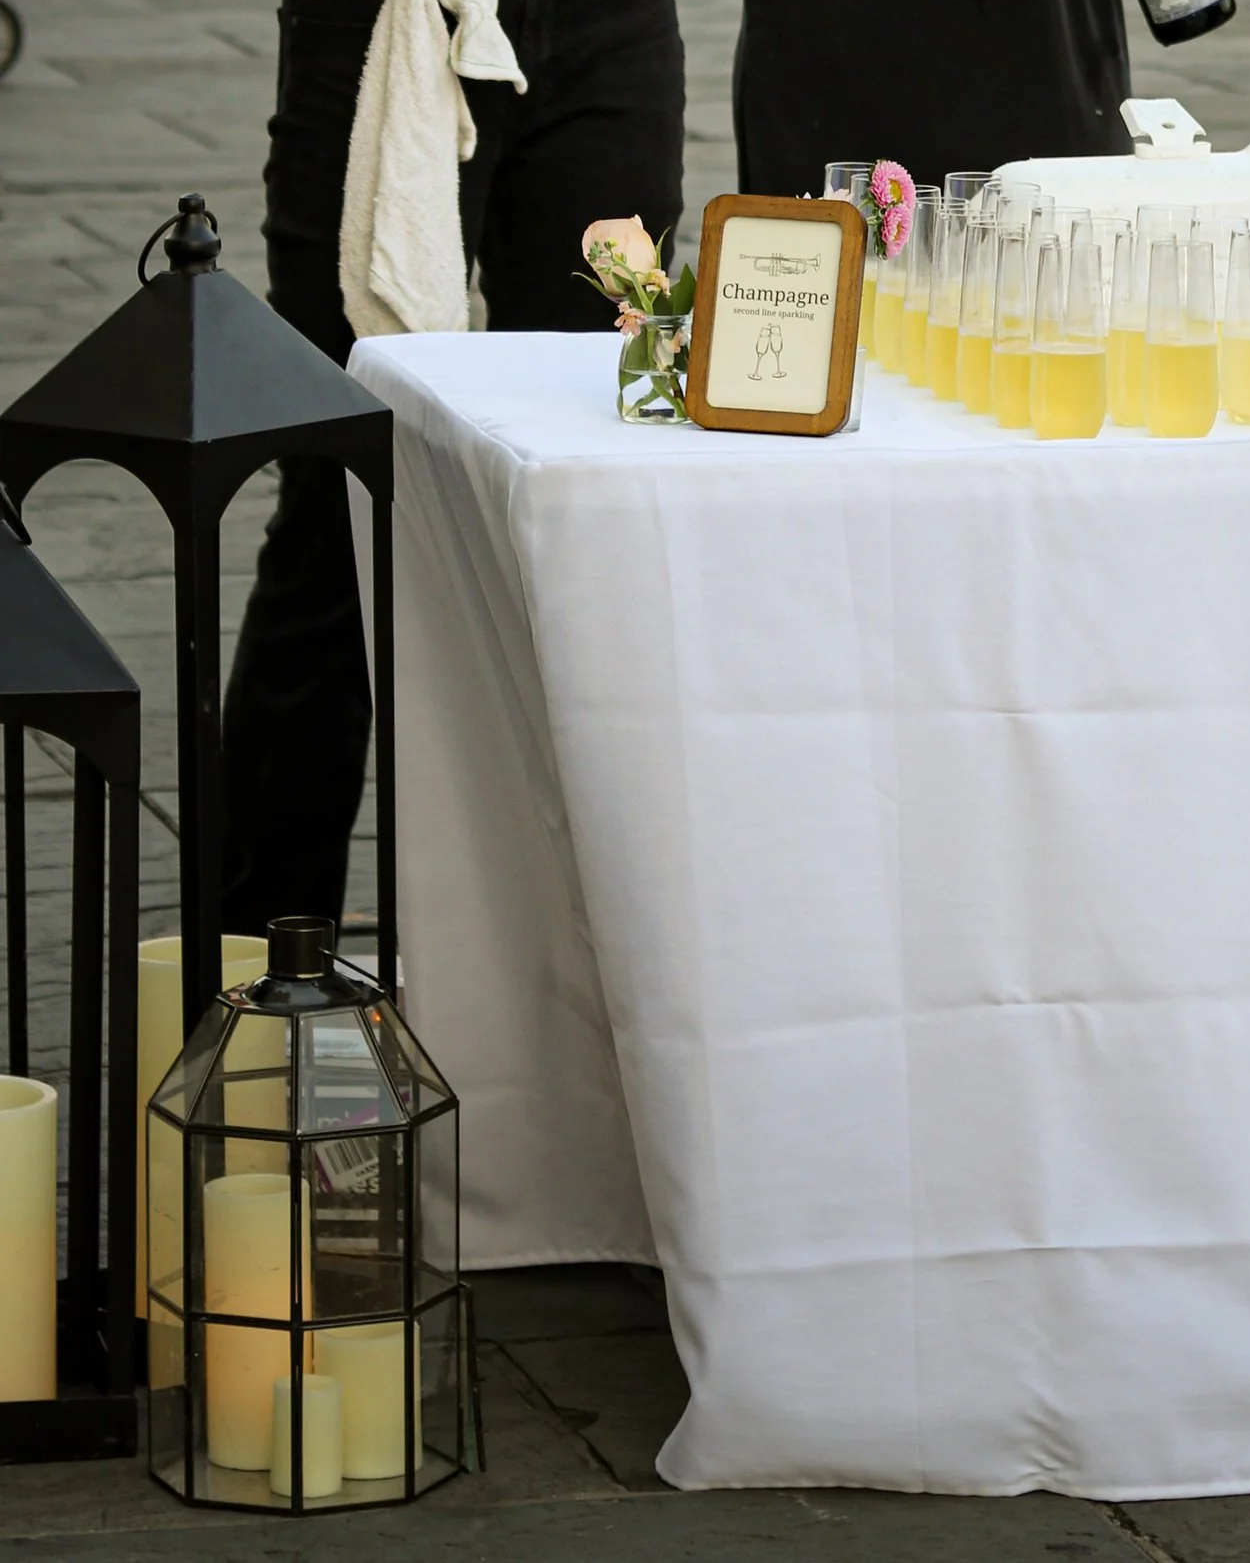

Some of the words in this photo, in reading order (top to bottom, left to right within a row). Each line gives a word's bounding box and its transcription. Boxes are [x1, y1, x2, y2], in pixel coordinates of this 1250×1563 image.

[722, 283, 830, 309] Champagne
[733, 308, 760, 316] second
[762, 308, 777, 317] line
[778, 310, 815, 321] sparkling
